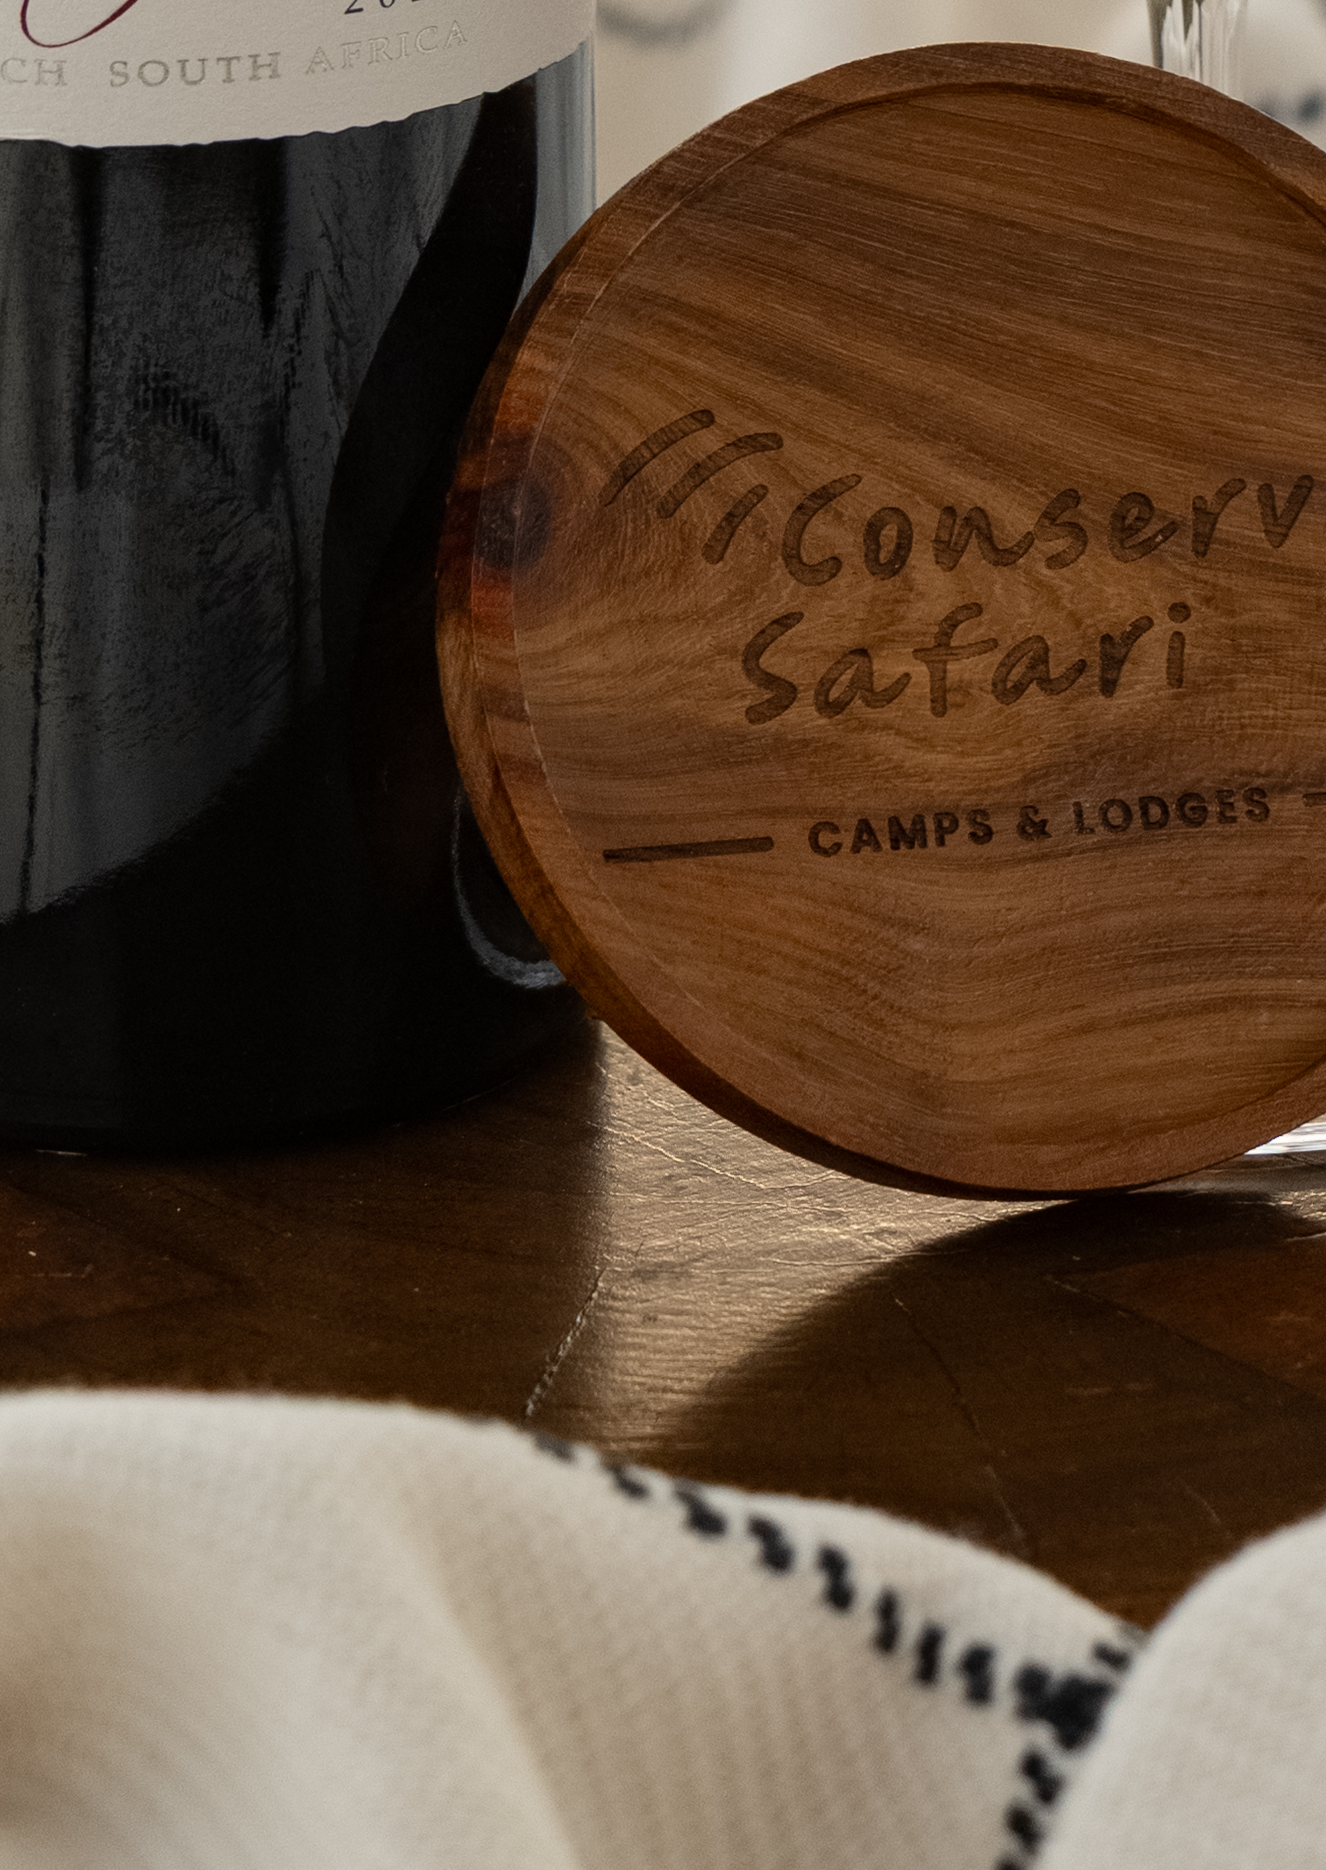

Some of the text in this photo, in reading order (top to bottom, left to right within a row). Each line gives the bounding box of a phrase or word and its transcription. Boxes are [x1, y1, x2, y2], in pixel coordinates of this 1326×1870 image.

[109, 51, 282, 88] SOUTH
[304, 19, 469, 76] AFRICA
[741, 601, 1193, 725] Safari
[808, 786, 1273, 858] CAMPS & LODGES
